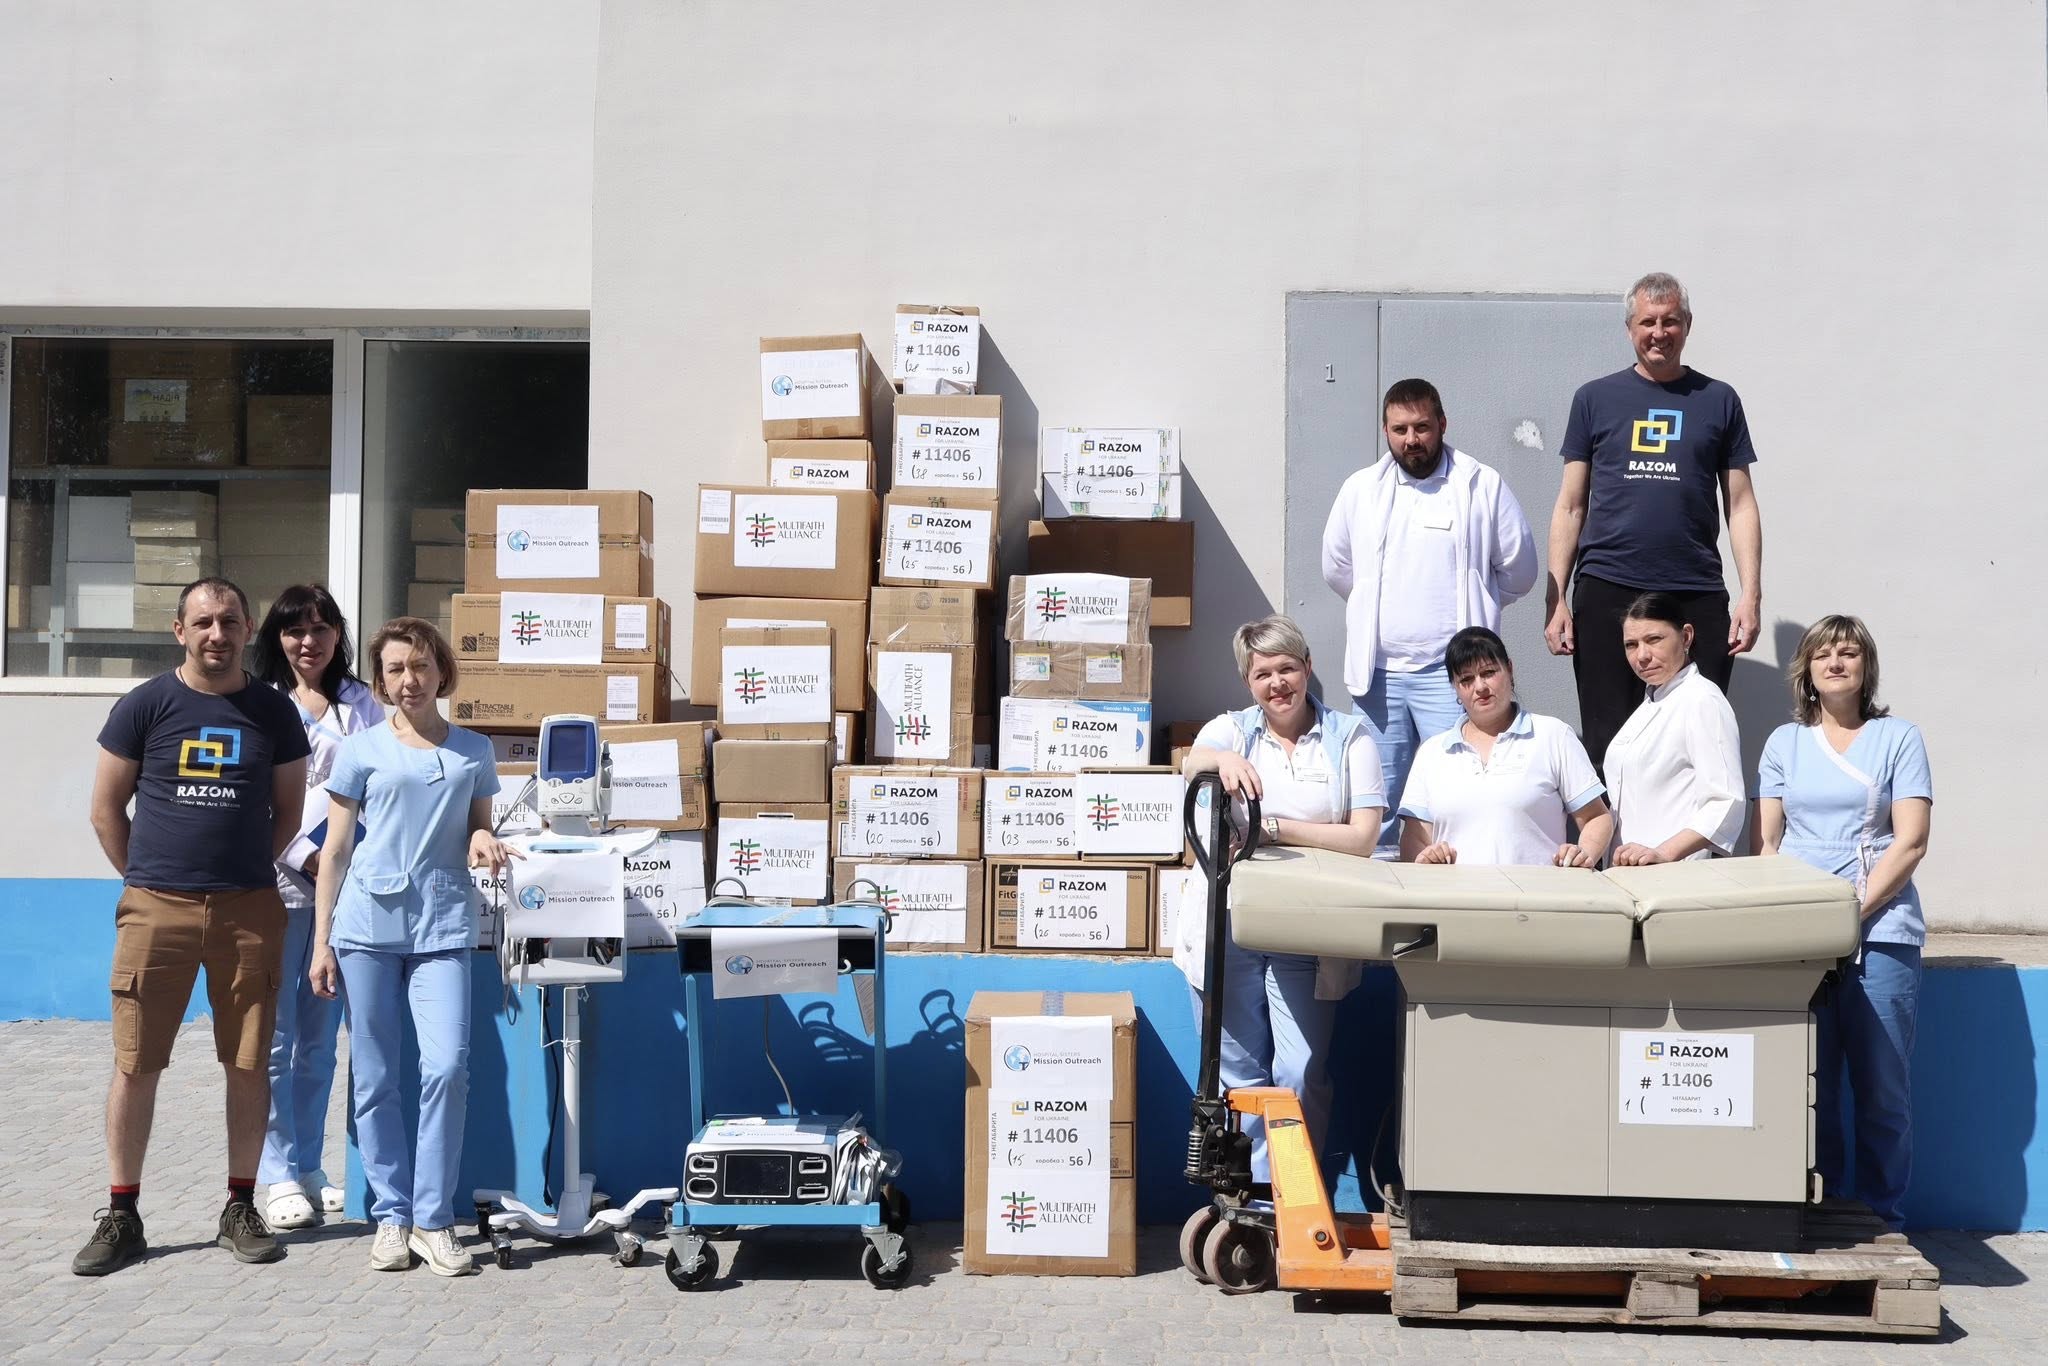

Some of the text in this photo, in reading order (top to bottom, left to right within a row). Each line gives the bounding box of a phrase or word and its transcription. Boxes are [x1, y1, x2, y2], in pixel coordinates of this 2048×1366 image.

[927, 324, 969, 333] RAZOM
[905, 344, 961, 357] # 11406
[952, 366, 964, 375] 56
[1325, 363, 1336, 383] 1
[820, 382, 849, 390] Outreach
[935, 426, 980, 437] RAZOM
[1099, 443, 1142, 453] RAZOM
[912, 448, 971, 462] # 11406
[1077, 464, 1134, 478] # 11406
[1629, 460, 1677, 473] RAZOM
[807, 468, 849, 478] RAZOM
[962, 472, 975, 481] 56
[1125, 487, 1138, 497] 56
[777, 520, 825, 530] MULTIFAITH
[926, 517, 972, 529] RAZOM
[778, 530, 823, 540] ALLIANCE
[902, 539, 962, 555] # 11406
[952, 565, 965, 575] 56
[1069, 595, 1118, 607] MULTIFAITH
[1069, 605, 1115, 616] ALLIANCE
[543, 619, 592, 629] MULTIFAITH
[544, 628, 590, 638] ALLIANCE
[768, 674, 819, 685] MULTIFAITH
[769, 684, 816, 694] ALLIANCE
[904, 663, 914, 713] MULTIFAITH
[913, 665, 923, 712] ALLIANCE
[1072, 720, 1118, 732] RAZOM
[1048, 743, 1108, 759] # 11406
[176, 785, 236, 799] RAZOM
[890, 787, 938, 798] RAZOM
[1025, 788, 1073, 798] RAZOM
[1121, 802, 1173, 813] MULTIFAITH
[866, 811, 930, 826] # 11406
[1001, 812, 1065, 826] # 11406
[1121, 812, 1170, 822] ALLIANCE
[920, 837, 934, 847] 56
[1056, 836, 1070, 847] 56
[763, 848, 815, 859] MULTIFAITH
[623, 860, 671, 872] RAZOM
[763, 858, 812, 869] ALLIANCE
[481, 879, 507, 889] RAZ
[1058, 881, 1107, 892] RAZOM
[624, 884, 664, 900] 1406
[998, 890, 1018, 899] FitG
[579, 895, 615, 903] Outreach
[902, 893, 953, 903] MULTIFAITH
[902, 903, 949, 912] ALLIANCE
[1034, 905, 1098, 920] # 11406
[656, 908, 670, 919] 56
[1088, 930, 1102, 941] 56
[1670, 1045, 1729, 1059] RAZOM
[1033, 1057, 1102, 1065] Mission Outreach
[1640, 1073, 1713, 1089] # 11406
[1034, 1101, 1088, 1112] RAZOM
[1670, 1106, 1698, 1114] коробка
[1713, 1107, 1719, 1116] 3
[1008, 1128, 1079, 1144] # 11406
[1069, 1155, 1084, 1167] 56
[1039, 1201, 1096, 1213] MULTIFAITH
[1039, 1213, 1093, 1225] ALLIANCE
